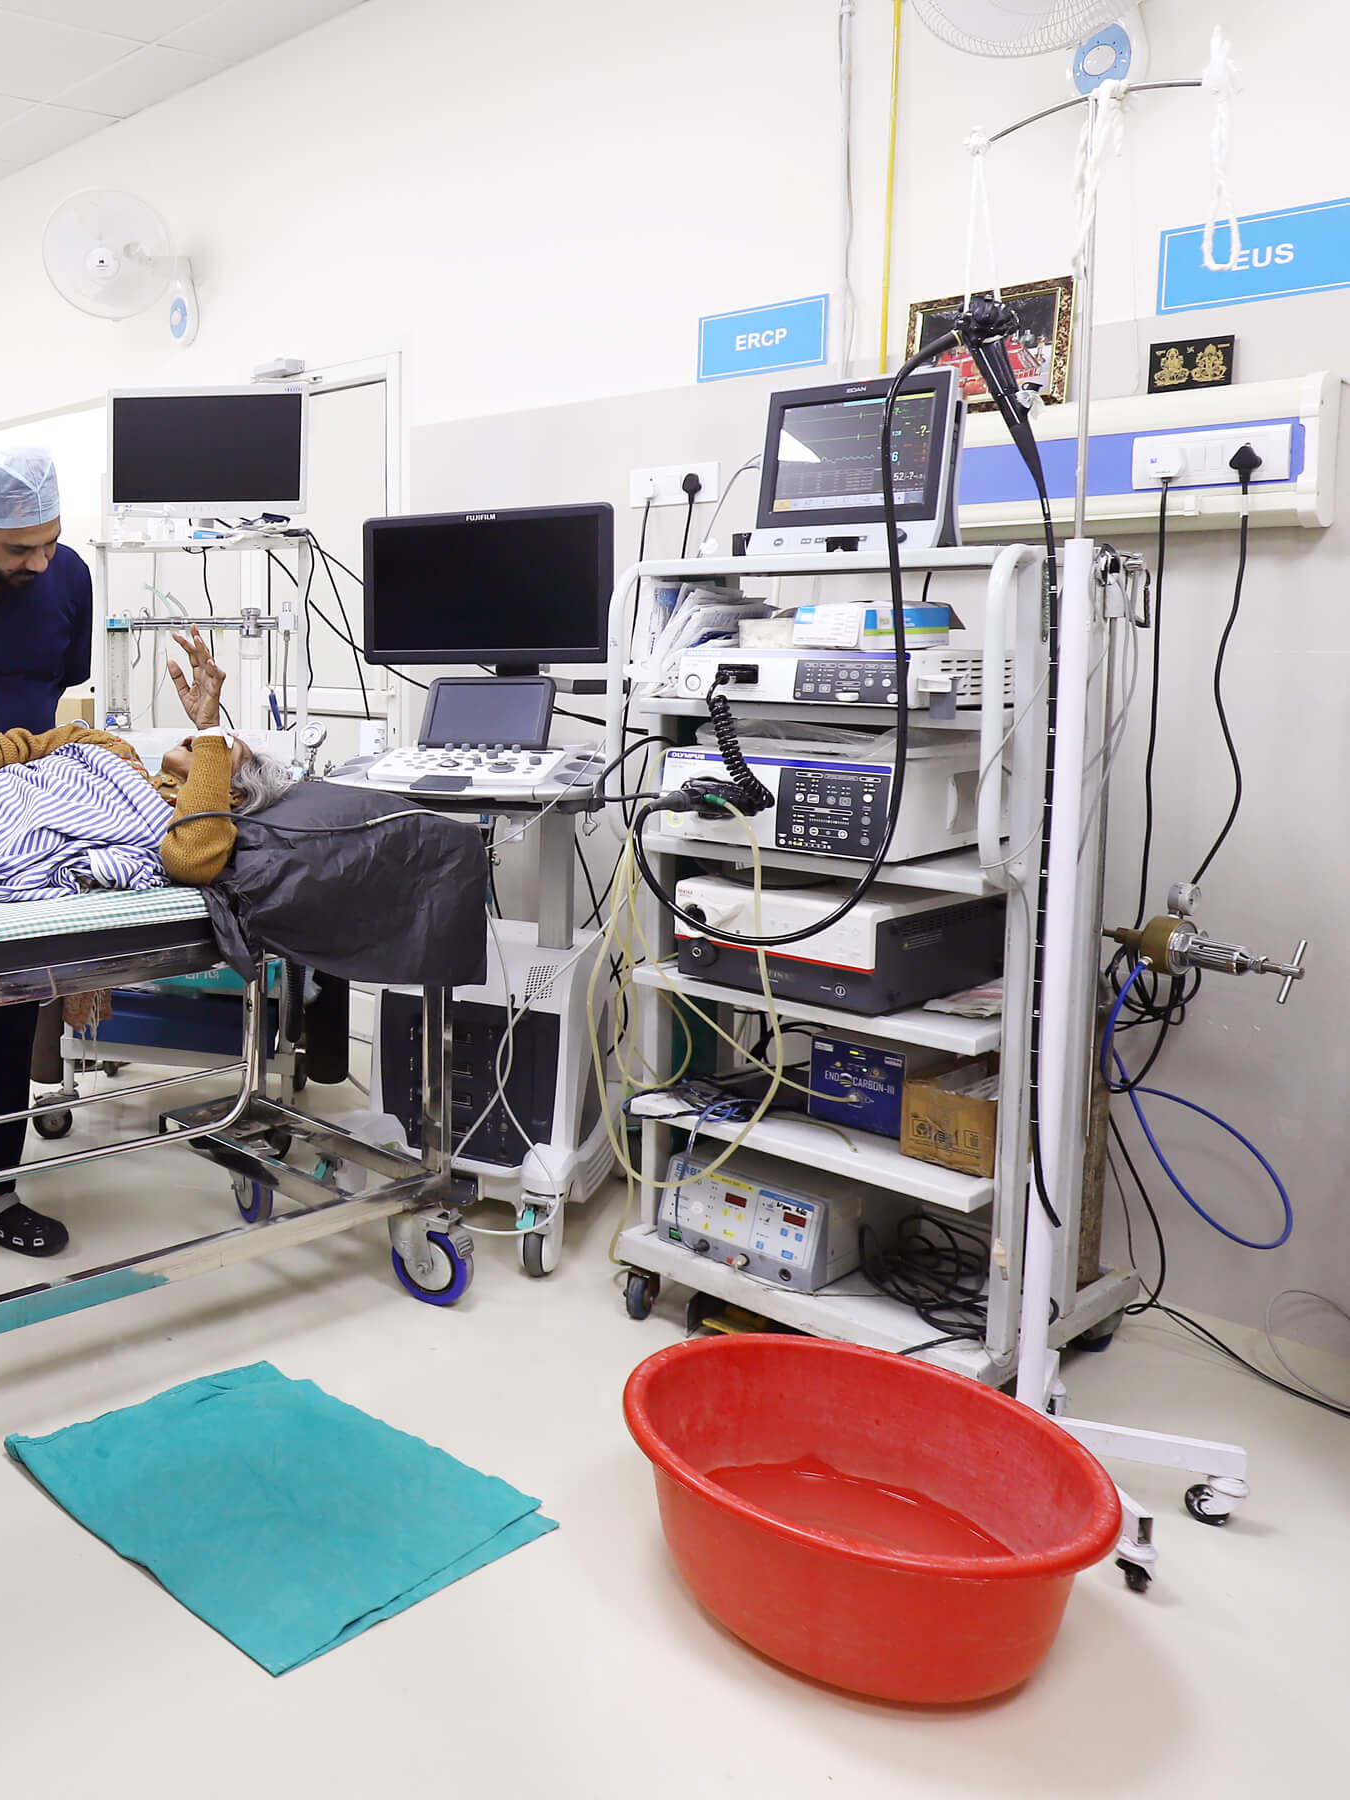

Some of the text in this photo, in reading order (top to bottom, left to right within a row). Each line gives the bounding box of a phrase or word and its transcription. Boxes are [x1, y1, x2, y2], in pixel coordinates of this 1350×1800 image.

[1231, 243, 1295, 271] EUS
[735, 328, 788, 351] ERCP
[846, 386, 867, 394] EDAN
[466, 513, 496, 521] FUJIFILM
[671, 752, 706, 760] OLYMPUS
